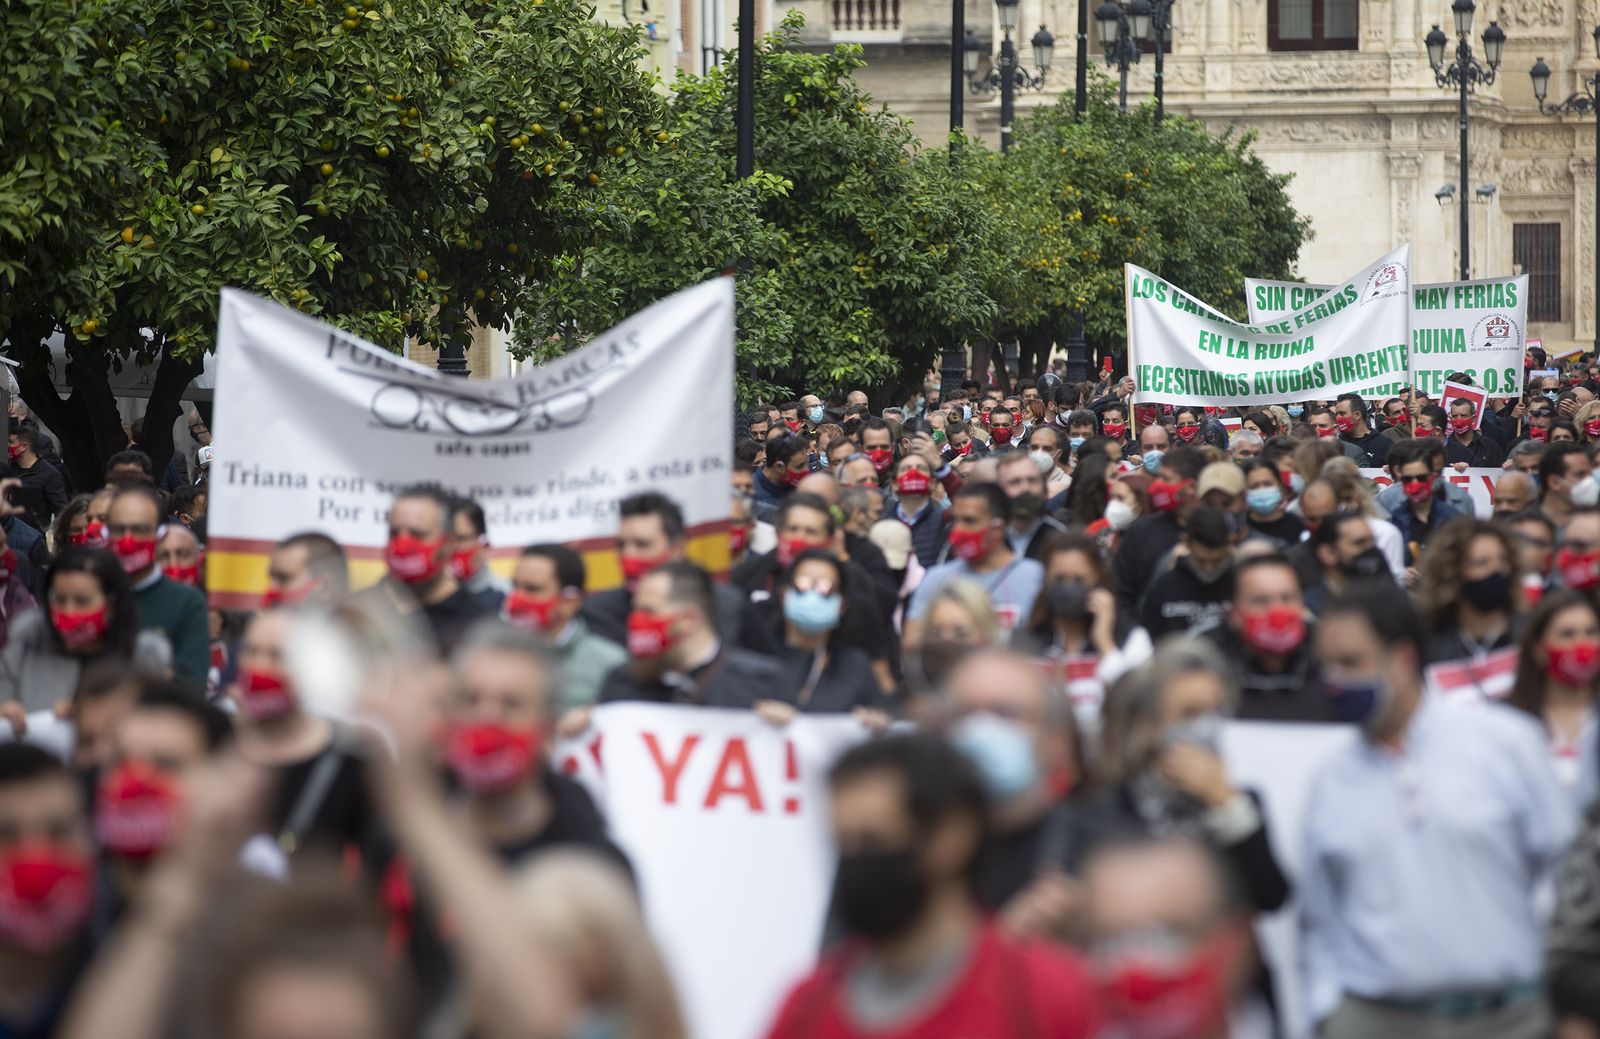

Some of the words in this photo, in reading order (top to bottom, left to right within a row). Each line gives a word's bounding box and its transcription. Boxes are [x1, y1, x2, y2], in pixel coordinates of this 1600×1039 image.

[1133, 274, 1167, 303] LOS
[1294, 284, 1358, 329] FERIAS
[1255, 286, 1286, 311] SIN
[1415, 287, 1449, 310] HAY
[1454, 282, 1518, 309] FERIAS
[1198, 330, 1222, 356] EN
[1226, 338, 1249, 361] LA
[1254, 335, 1314, 361] RUINA
[1136, 364, 1250, 397] NECESITAMOS
[1254, 361, 1323, 395] AYUDAS
[223, 462, 308, 489] Triana
[319, 474, 365, 493] con
[648, 457, 693, 481] esta
[318, 498, 362, 521] Por
[640, 730, 799, 814] YA!
